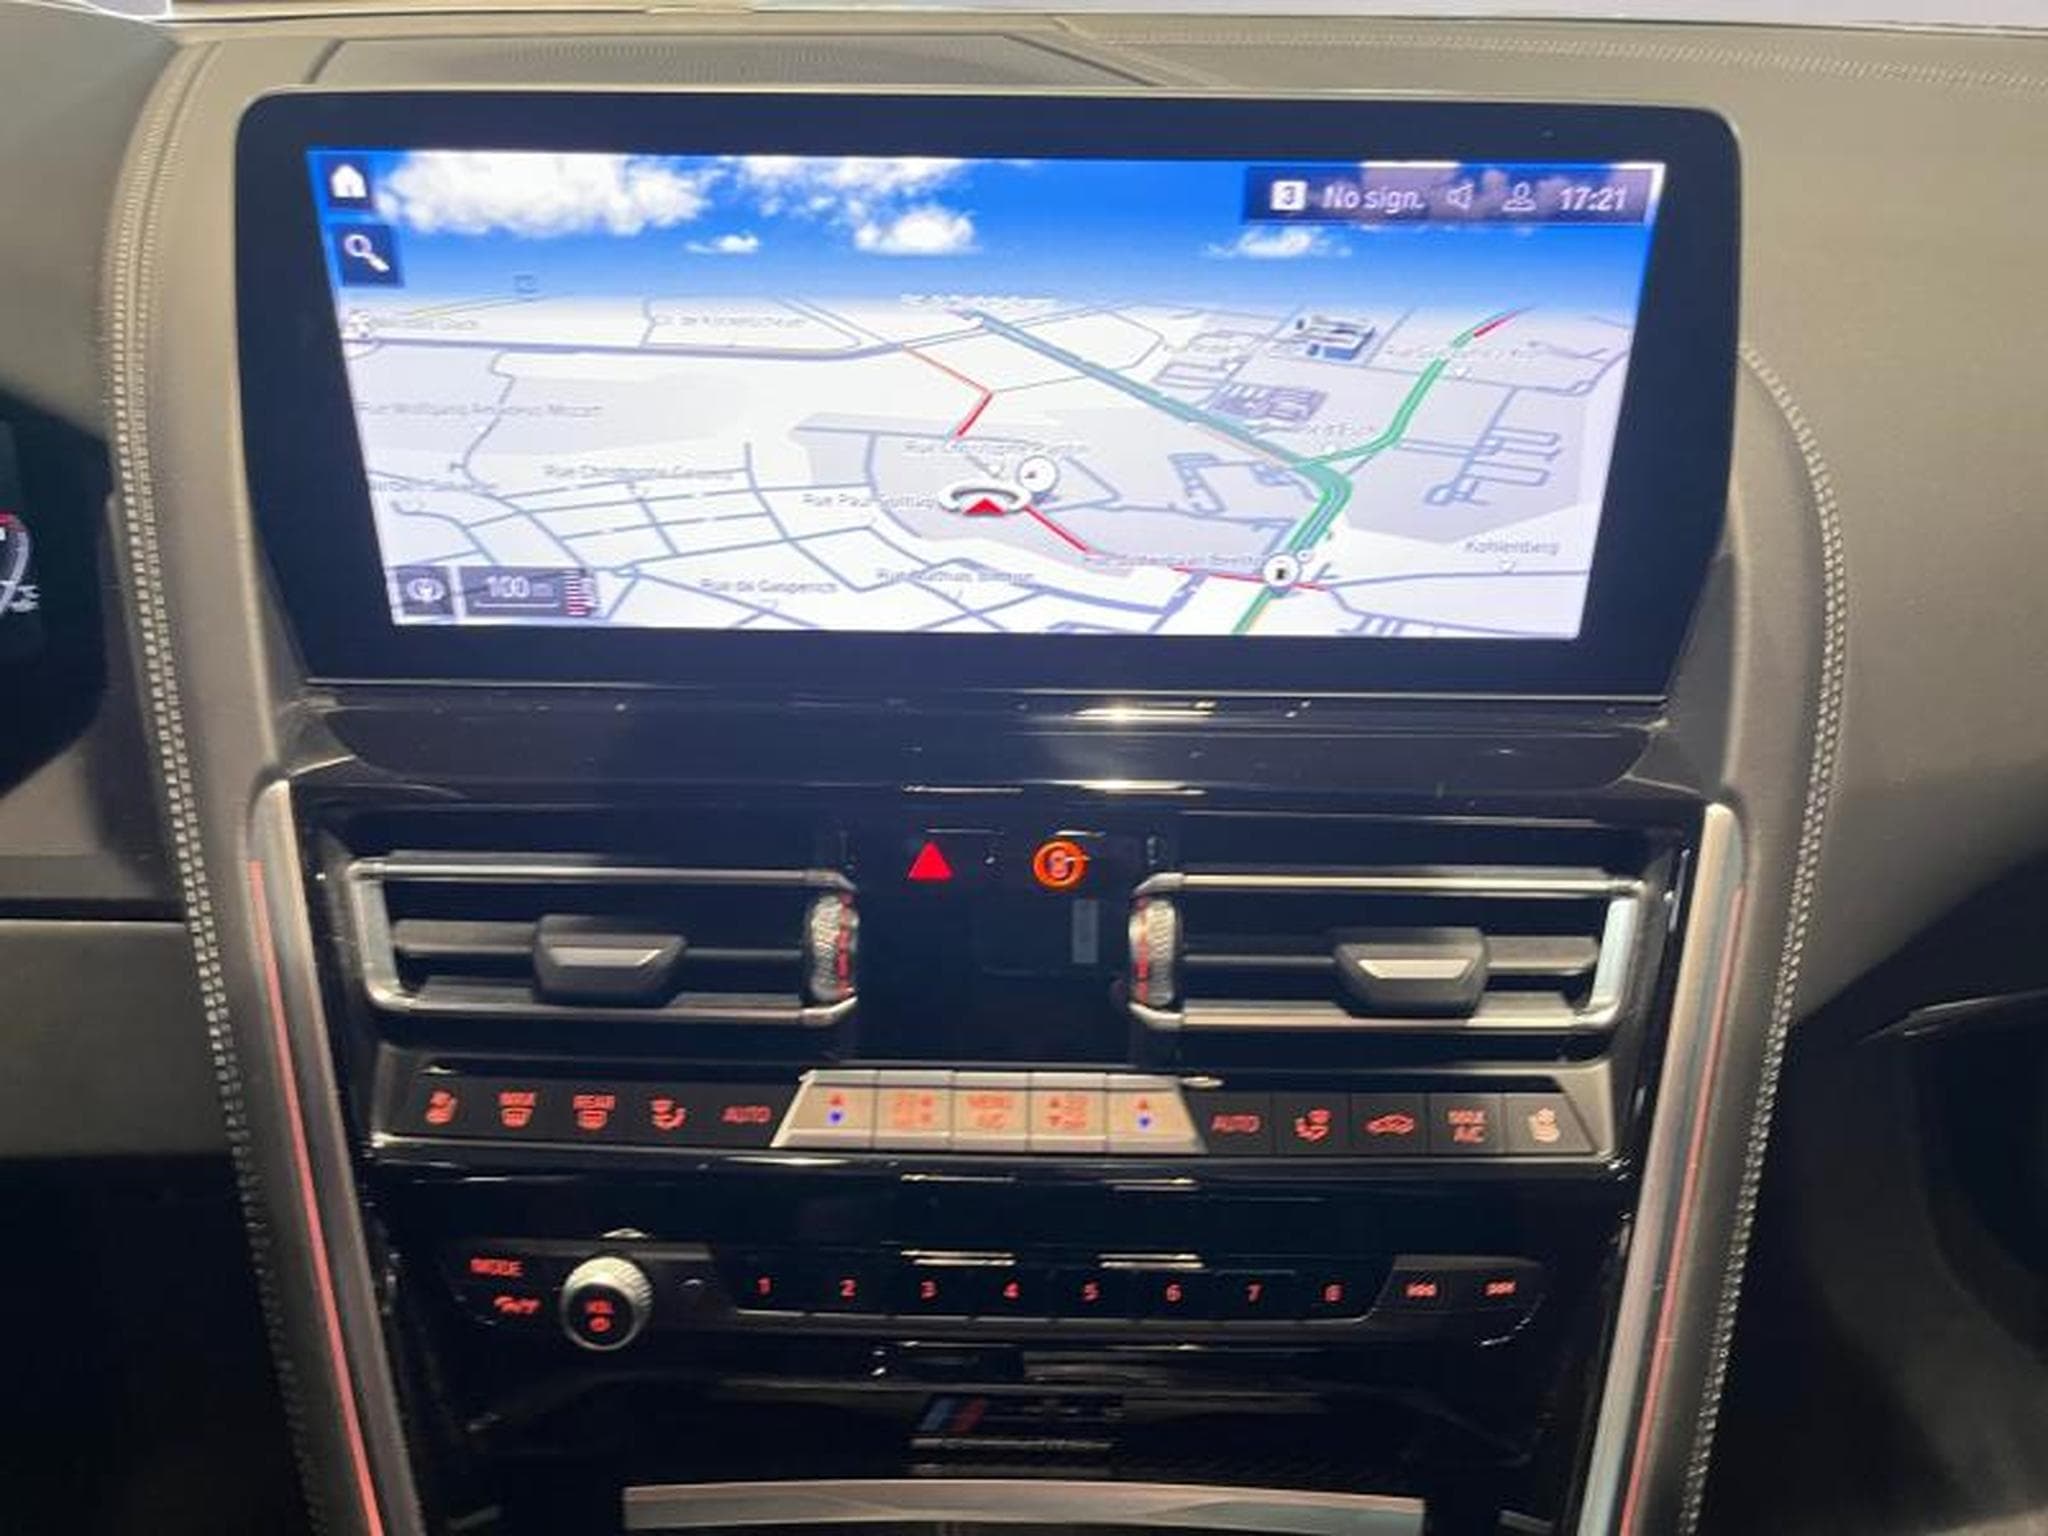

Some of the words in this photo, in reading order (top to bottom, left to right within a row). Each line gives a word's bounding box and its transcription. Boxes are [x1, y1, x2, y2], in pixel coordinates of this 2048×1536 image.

[1322, 186, 1359, 209] No
[1366, 187, 1427, 214] sign.
[1559, 186, 1626, 211] 17:21
[839, 1279, 857, 1297] 2
[920, 1281, 936, 1298] 3
[1003, 1282, 1020, 1299] 4
[1082, 1282, 1099, 1300] 5
[1165, 1284, 1182, 1301] 6
[1248, 1283, 1263, 1301] 7
